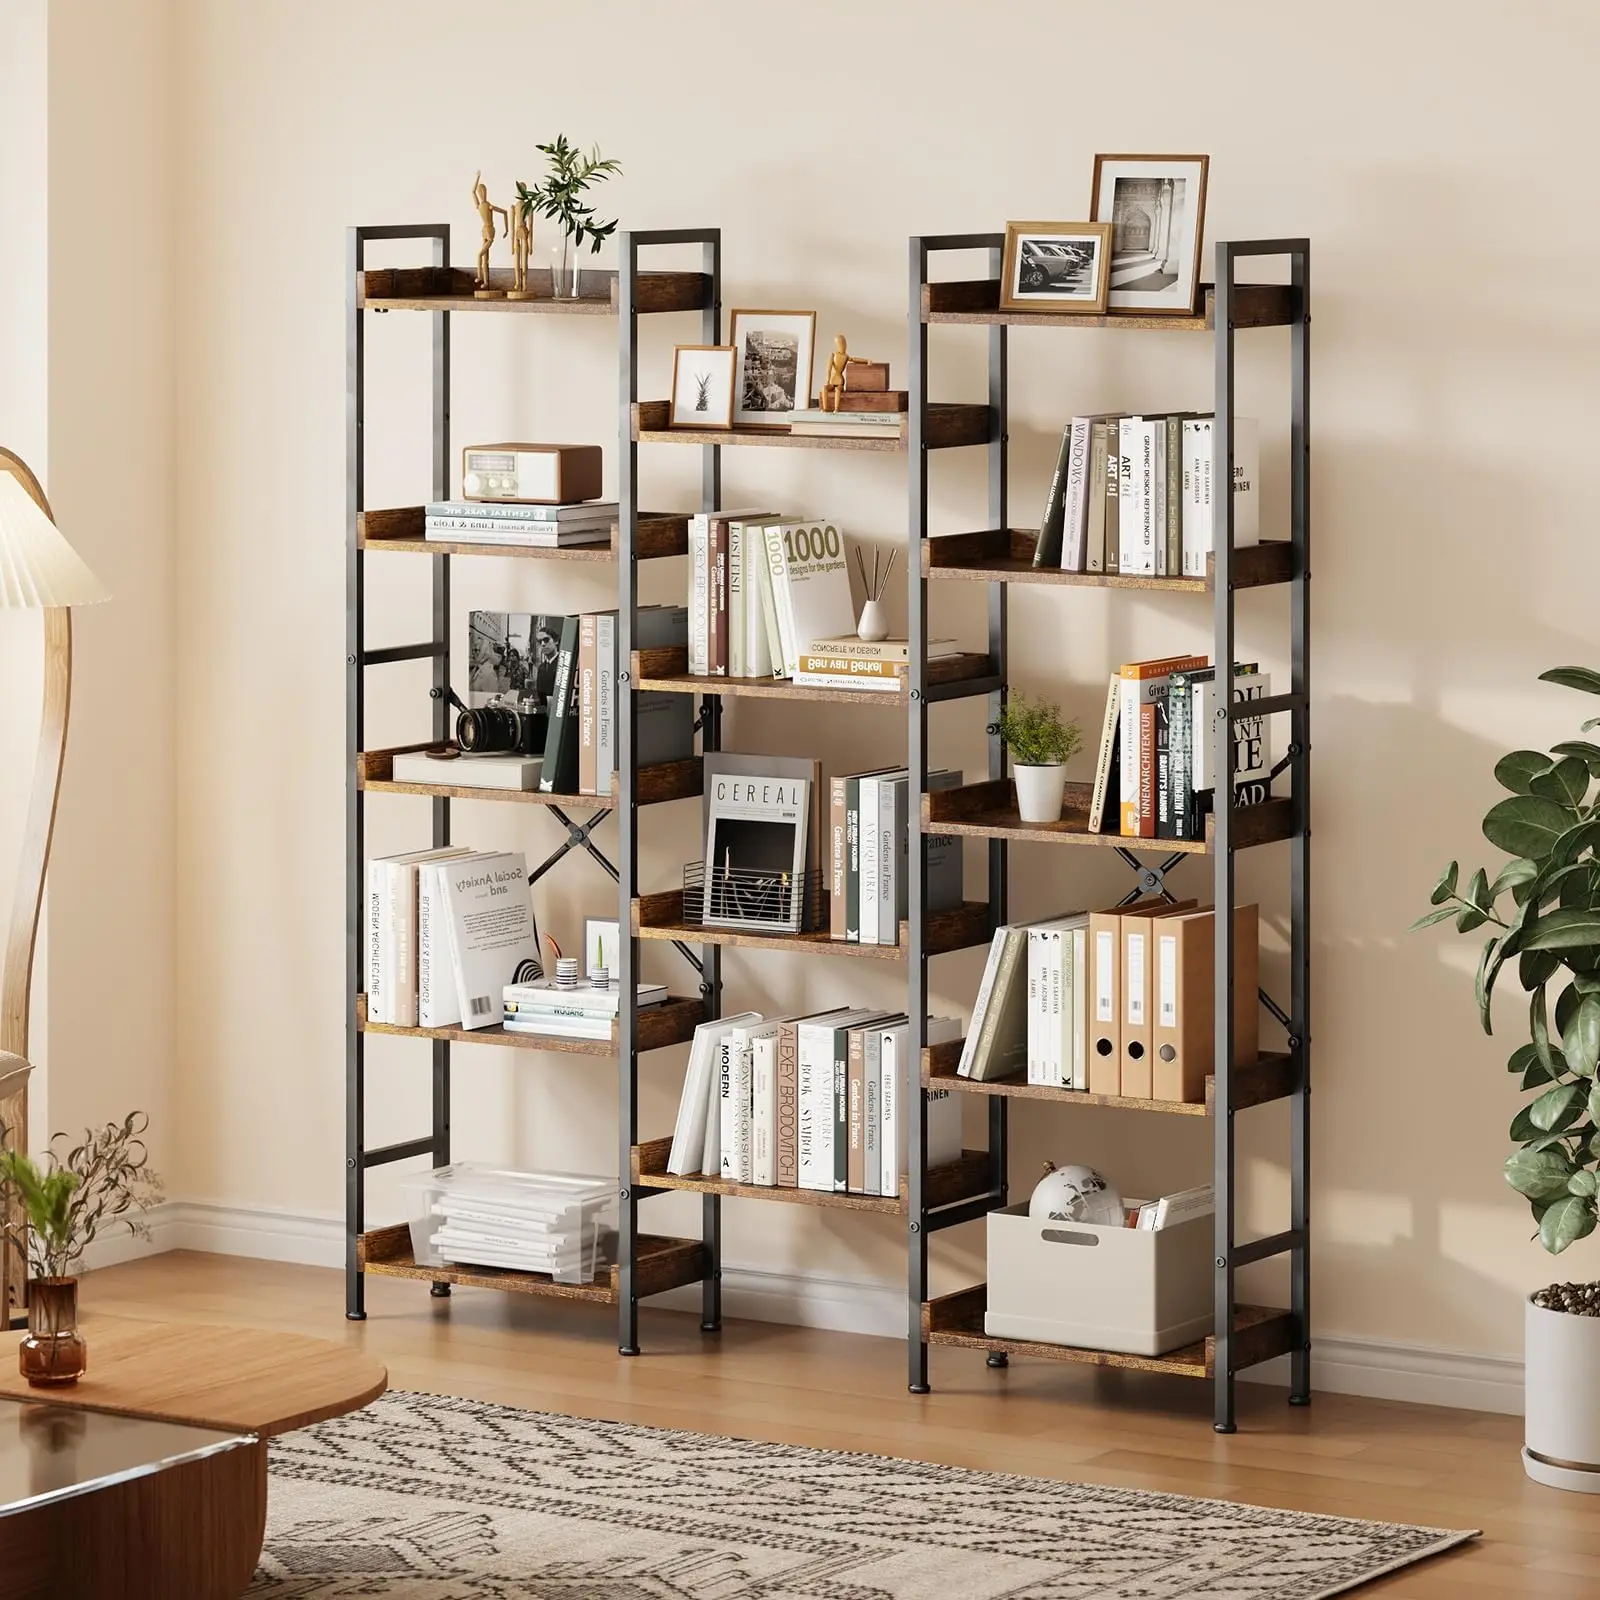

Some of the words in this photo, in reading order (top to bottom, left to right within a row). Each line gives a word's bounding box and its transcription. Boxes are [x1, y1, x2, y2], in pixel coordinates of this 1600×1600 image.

[1071, 423, 1086, 485] WINDOWS
[1107, 454, 1117, 480] ART
[1121, 455, 1131, 480] ART
[731, 526, 740, 561] LOST
[767, 531, 784, 576] 1000
[783, 525, 840, 563] 1000
[731, 564, 740, 593] FISH
[789, 564, 809, 576] designs
[808, 562, 816, 572] for
[816, 561, 825, 572] the
[825, 559, 846, 573] gardens
[583, 668, 593, 705] Gardens
[600, 670, 610, 705] Gardens
[1148, 684, 1165, 697] Give
[583, 706, 593, 715] in
[600, 706, 610, 716] in
[583, 716, 593, 747] France
[600, 718, 610, 748] France
[1101, 739, 1110, 774] RAYMOND
[1141, 712, 1151, 818] INNENARCHITEKTUR
[1159, 754, 1167, 790] GRAVITY'S
[717, 782, 798, 805] CEREAL
[1159, 790, 1168, 823] RAINBOW
[834, 825, 843, 858] Gardens
[882, 830, 892, 863] Gardens
[834, 859, 843, 867] in
[882, 864, 892, 873] in
[834, 868, 843, 896] France
[882, 873, 892, 901] France
[780, 1027, 795, 1083] ALEXEY
[721, 1044, 730, 1099] MODERN
[801, 1063, 812, 1096] BOOK
[852, 1079, 861, 1112] Gardens
[868, 1080, 877, 1114] Gardens
[926, 1088, 949, 1102] RINEN
[741, 1098, 749, 1141] MICHAEL
[780, 1086, 795, 1176] BRODOVITCH
[852, 1112, 861, 1121] in
[868, 1114, 877, 1122] in
[741, 1143, 749, 1153] IS
[801, 1109, 812, 1167] SYMBOLS
[852, 1122, 861, 1149] France
[868, 1123, 877, 1151] France
[722, 1157, 730, 1168] A
[741, 1155, 749, 1183] WHO
